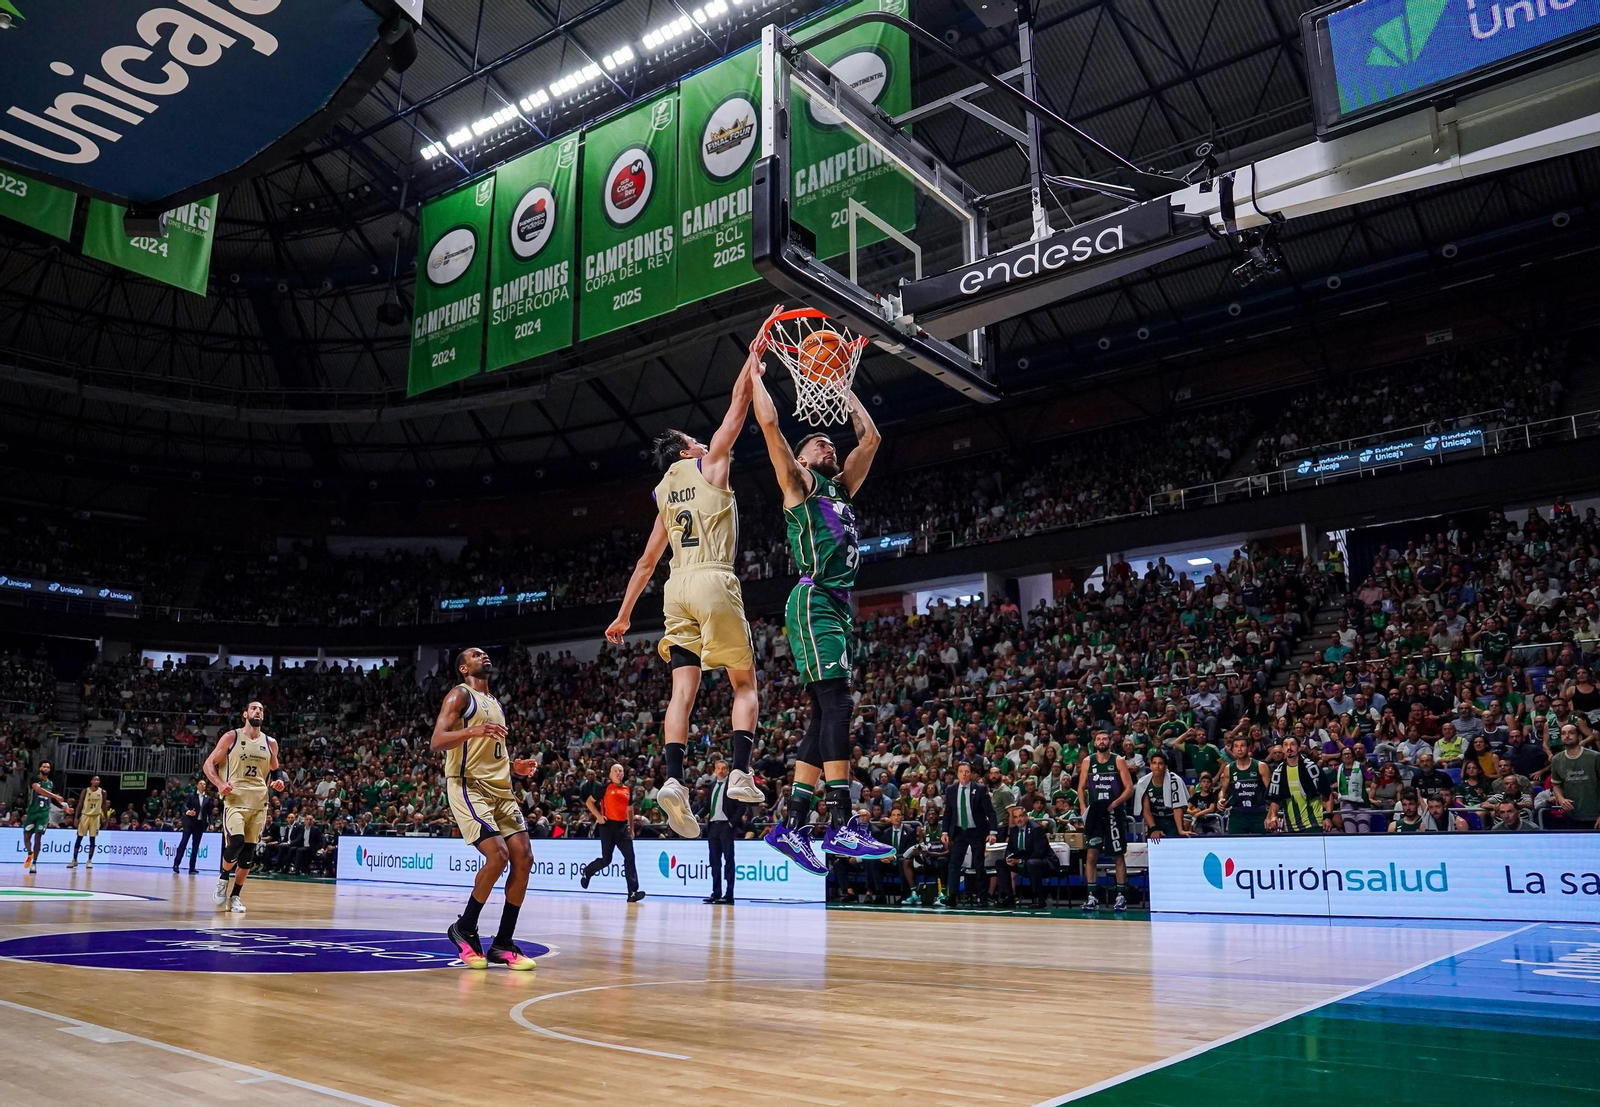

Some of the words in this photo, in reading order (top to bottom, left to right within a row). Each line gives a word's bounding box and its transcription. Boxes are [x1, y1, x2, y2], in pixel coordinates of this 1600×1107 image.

[707, 137, 730, 151] FINAL
[730, 126, 751, 141] FOUR
[796, 193, 817, 207] FIBA
[841, 186, 857, 199] CUP
[130, 236, 169, 258] 2024
[715, 226, 744, 248] BCL
[584, 225, 674, 281] CAMPEONES
[713, 242, 746, 269] 2025
[959, 224, 1125, 296] endesa
[585, 274, 616, 293] COPA
[619, 265, 642, 282] DEL
[647, 250, 673, 270] REY
[492, 260, 569, 311] CAMPEONES
[492, 287, 570, 326] SUPERCOPA
[612, 286, 642, 311] 2025
[414, 292, 481, 340] CAMPEONES
[514, 318, 542, 340] 2024
[431, 346, 456, 368] 2024
[1441, 437, 1472, 449] Unicaja
[675, 509, 700, 548] 2
[7, 579, 32, 589] Unicaja
[60, 585, 84, 596] Unicaja
[110, 591, 133, 602] Unicaja
[494, 741, 503, 760] 0
[244, 765, 258, 778] 23
[41, 840, 72, 854] alud
[123, 846, 148, 857] persona
[366, 852, 434, 871] quirónsalud
[449, 855, 462, 872] La
[558, 861, 566, 876] a
[1235, 861, 1449, 900] quirónsalud
[1504, 864, 1546, 895] La
